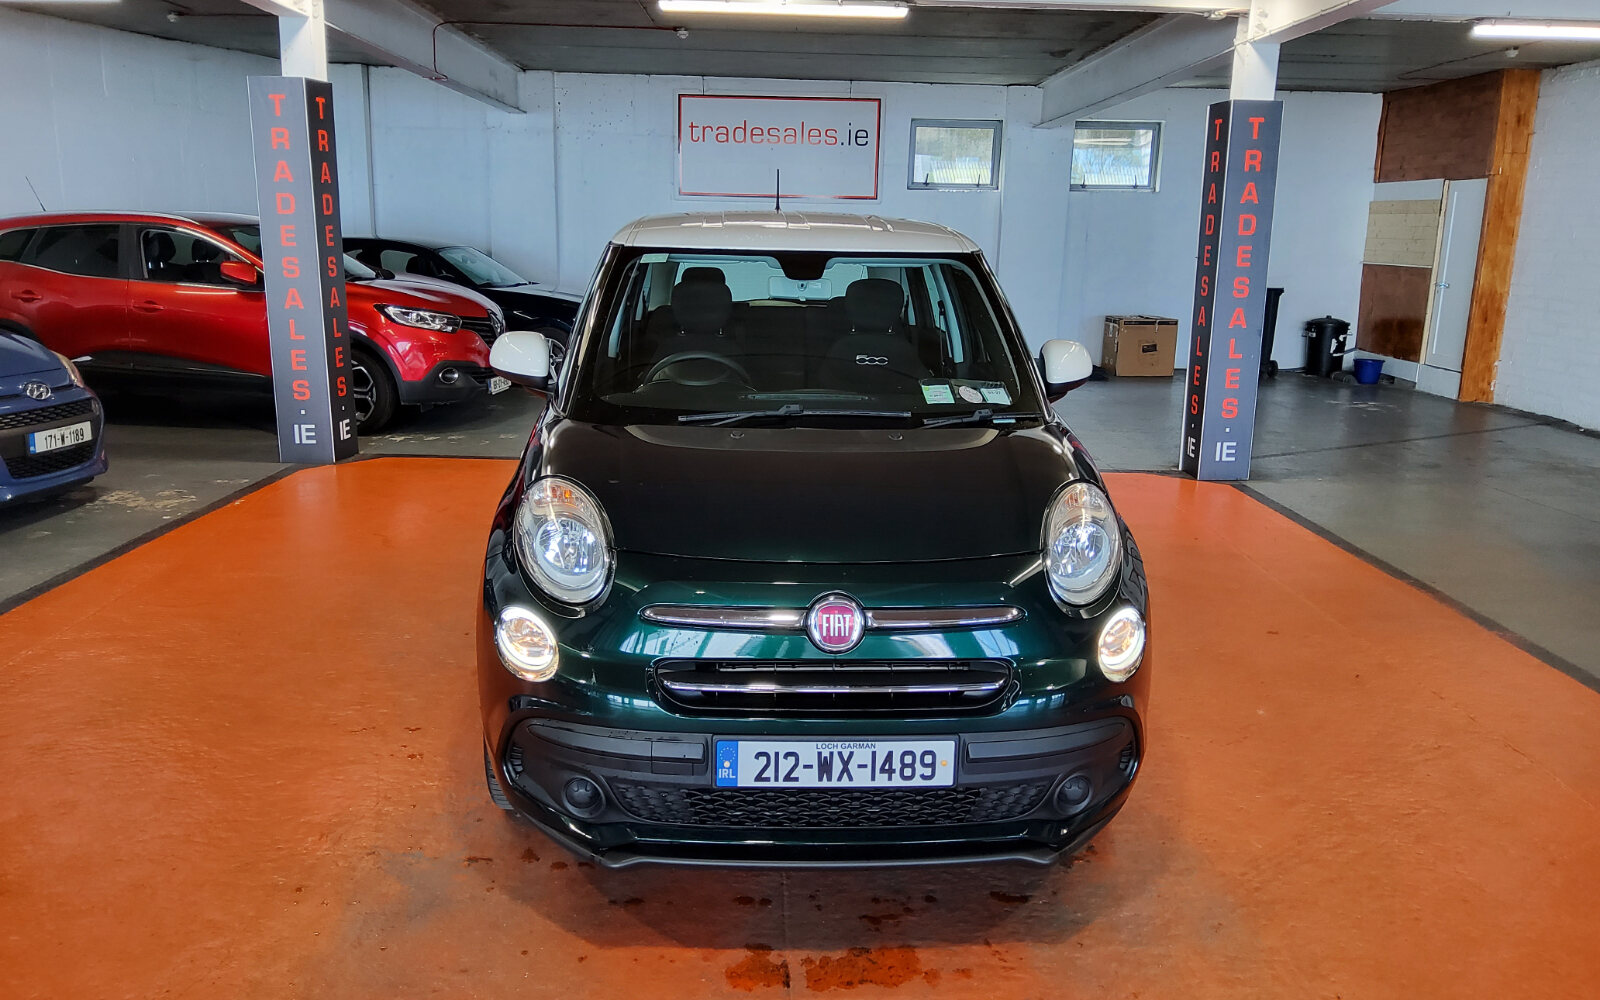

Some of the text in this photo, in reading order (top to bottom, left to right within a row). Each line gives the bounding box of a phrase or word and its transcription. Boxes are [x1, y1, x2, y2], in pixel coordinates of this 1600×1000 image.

[688, 120, 869, 146] tradesales.ie
[44, 428, 84, 448] 171-W-1189
[822, 614, 852, 637] FIAT
[718, 769, 736, 779] IRL
[753, 750, 937, 783] 212-WX-1489
